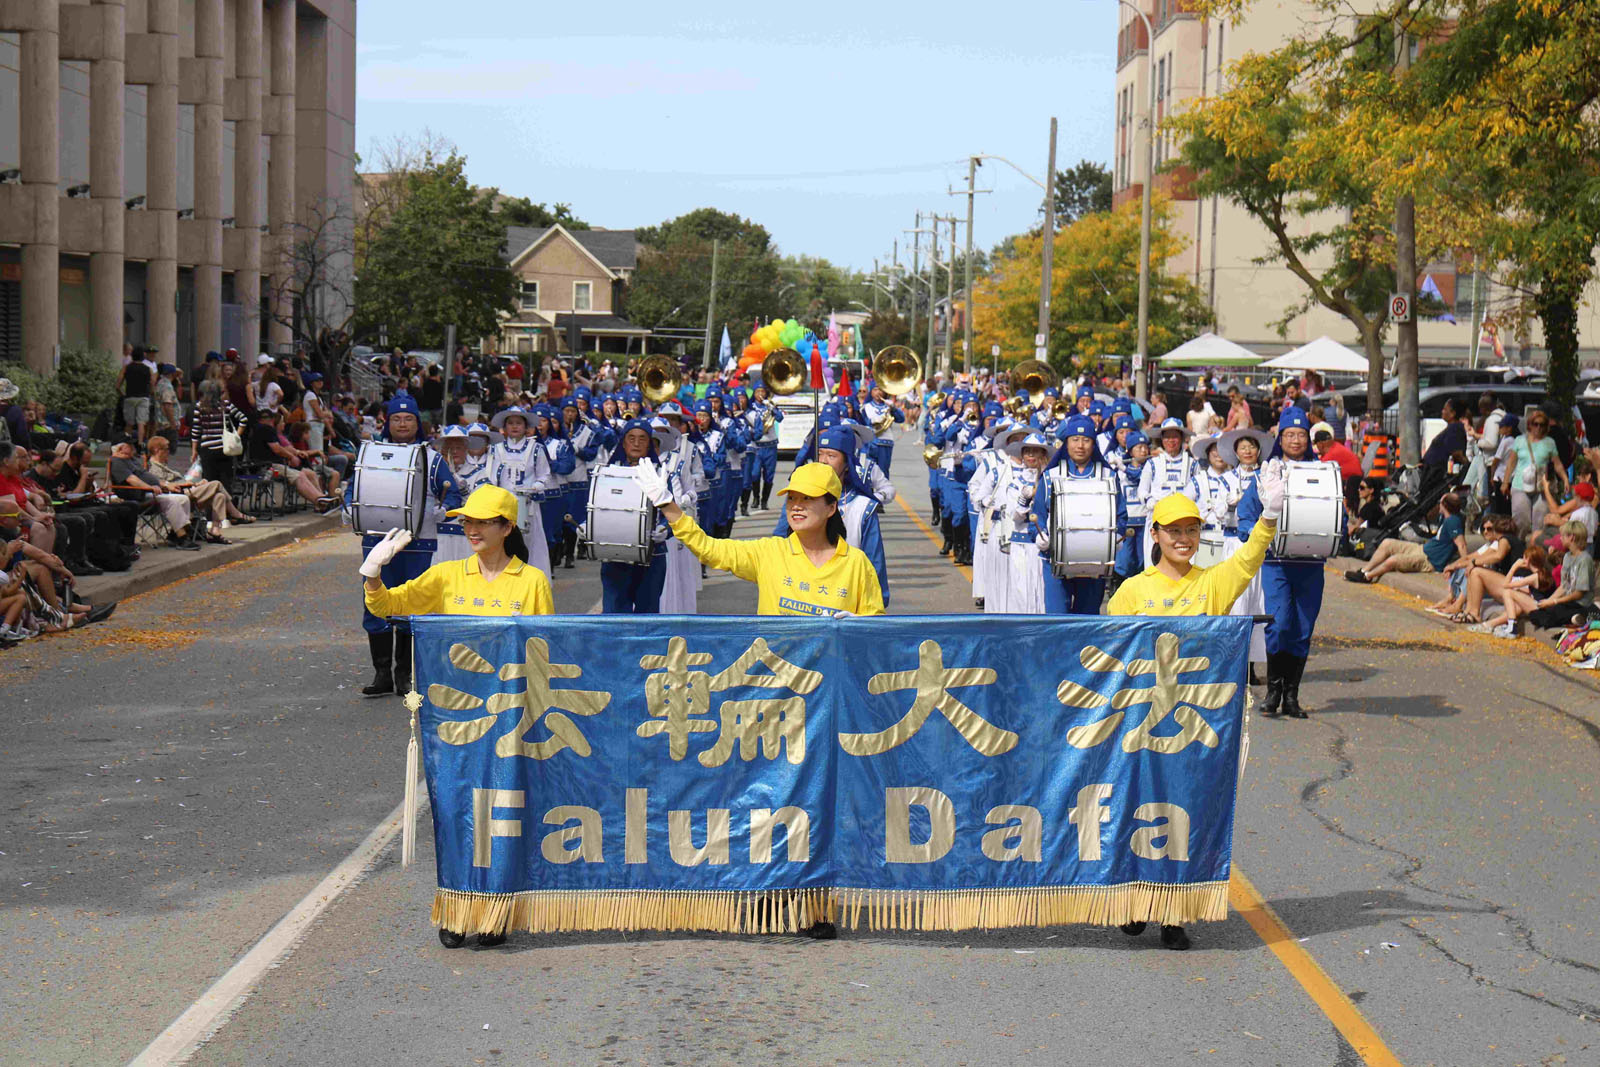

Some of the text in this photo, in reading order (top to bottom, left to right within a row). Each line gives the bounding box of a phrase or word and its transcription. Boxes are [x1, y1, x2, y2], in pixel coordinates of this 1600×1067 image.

[783, 575, 848, 598] 法輪大法
[453, 595, 521, 610] 法輪大法
[781, 599, 813, 612] FALUN
[428, 632, 1238, 768] 法輪大法
[472, 783, 1190, 868] Falun Dafa
